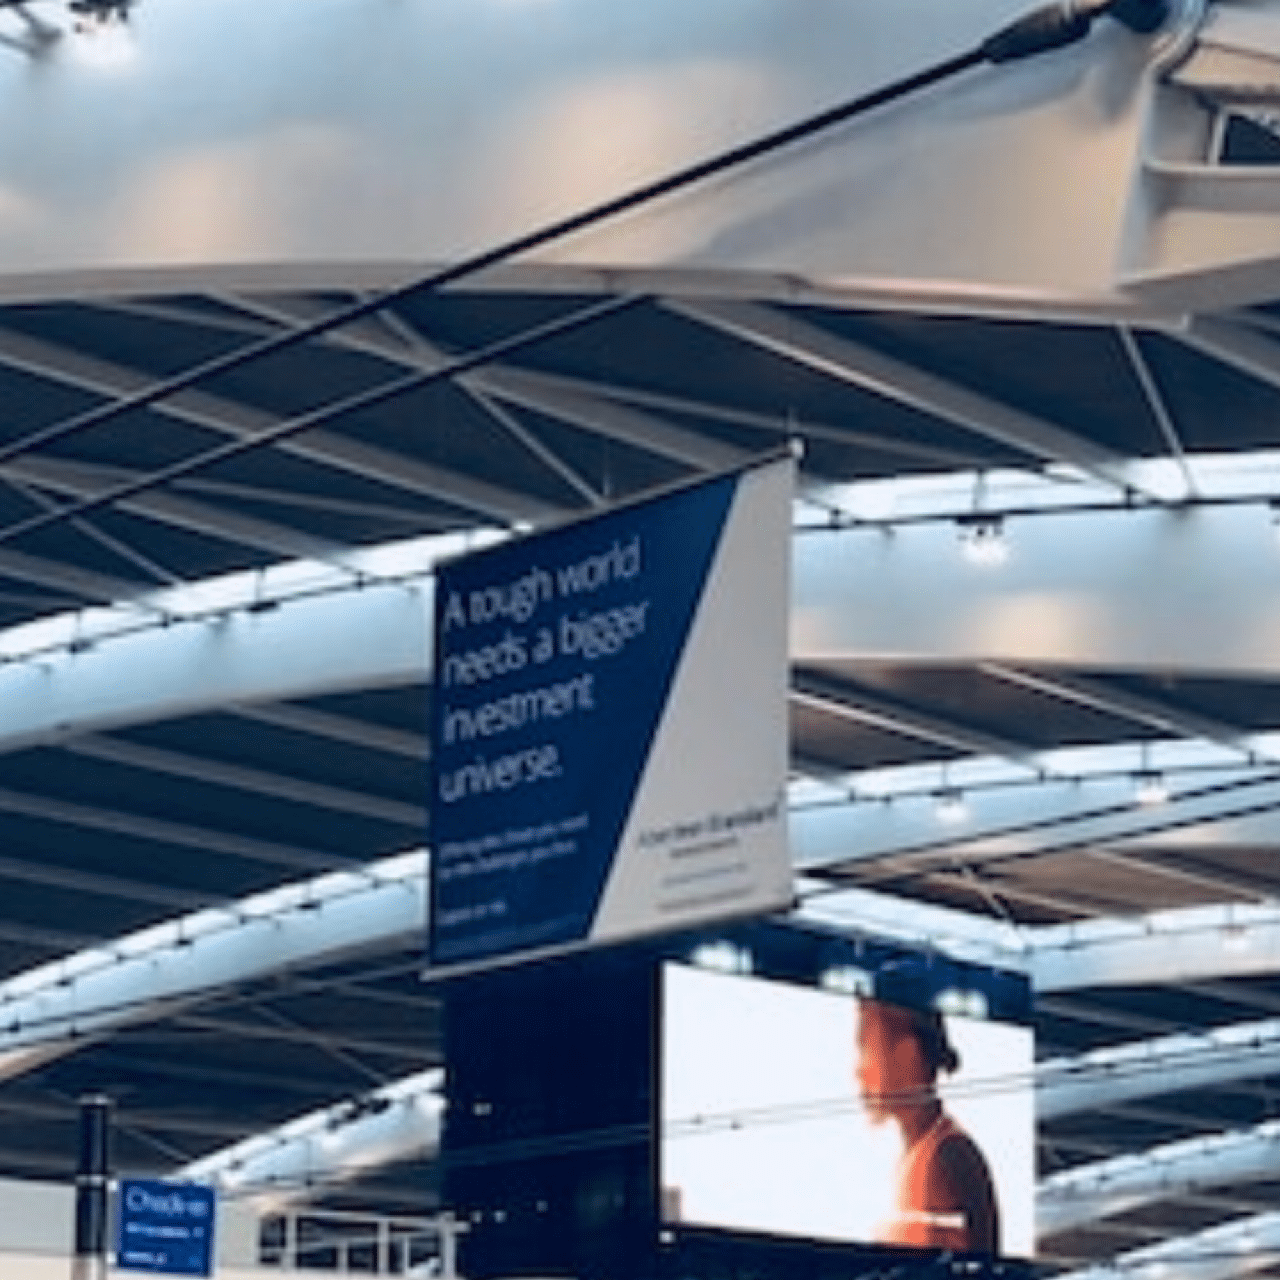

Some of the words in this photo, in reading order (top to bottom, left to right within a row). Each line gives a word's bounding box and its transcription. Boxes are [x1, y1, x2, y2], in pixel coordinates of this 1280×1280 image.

[444, 590, 466, 633] A
[469, 566, 554, 624] tough
[557, 535, 641, 597] world
[443, 629, 528, 688] needs
[532, 627, 554, 664] a
[560, 600, 650, 660] bigger
[443, 673, 595, 745] investment
